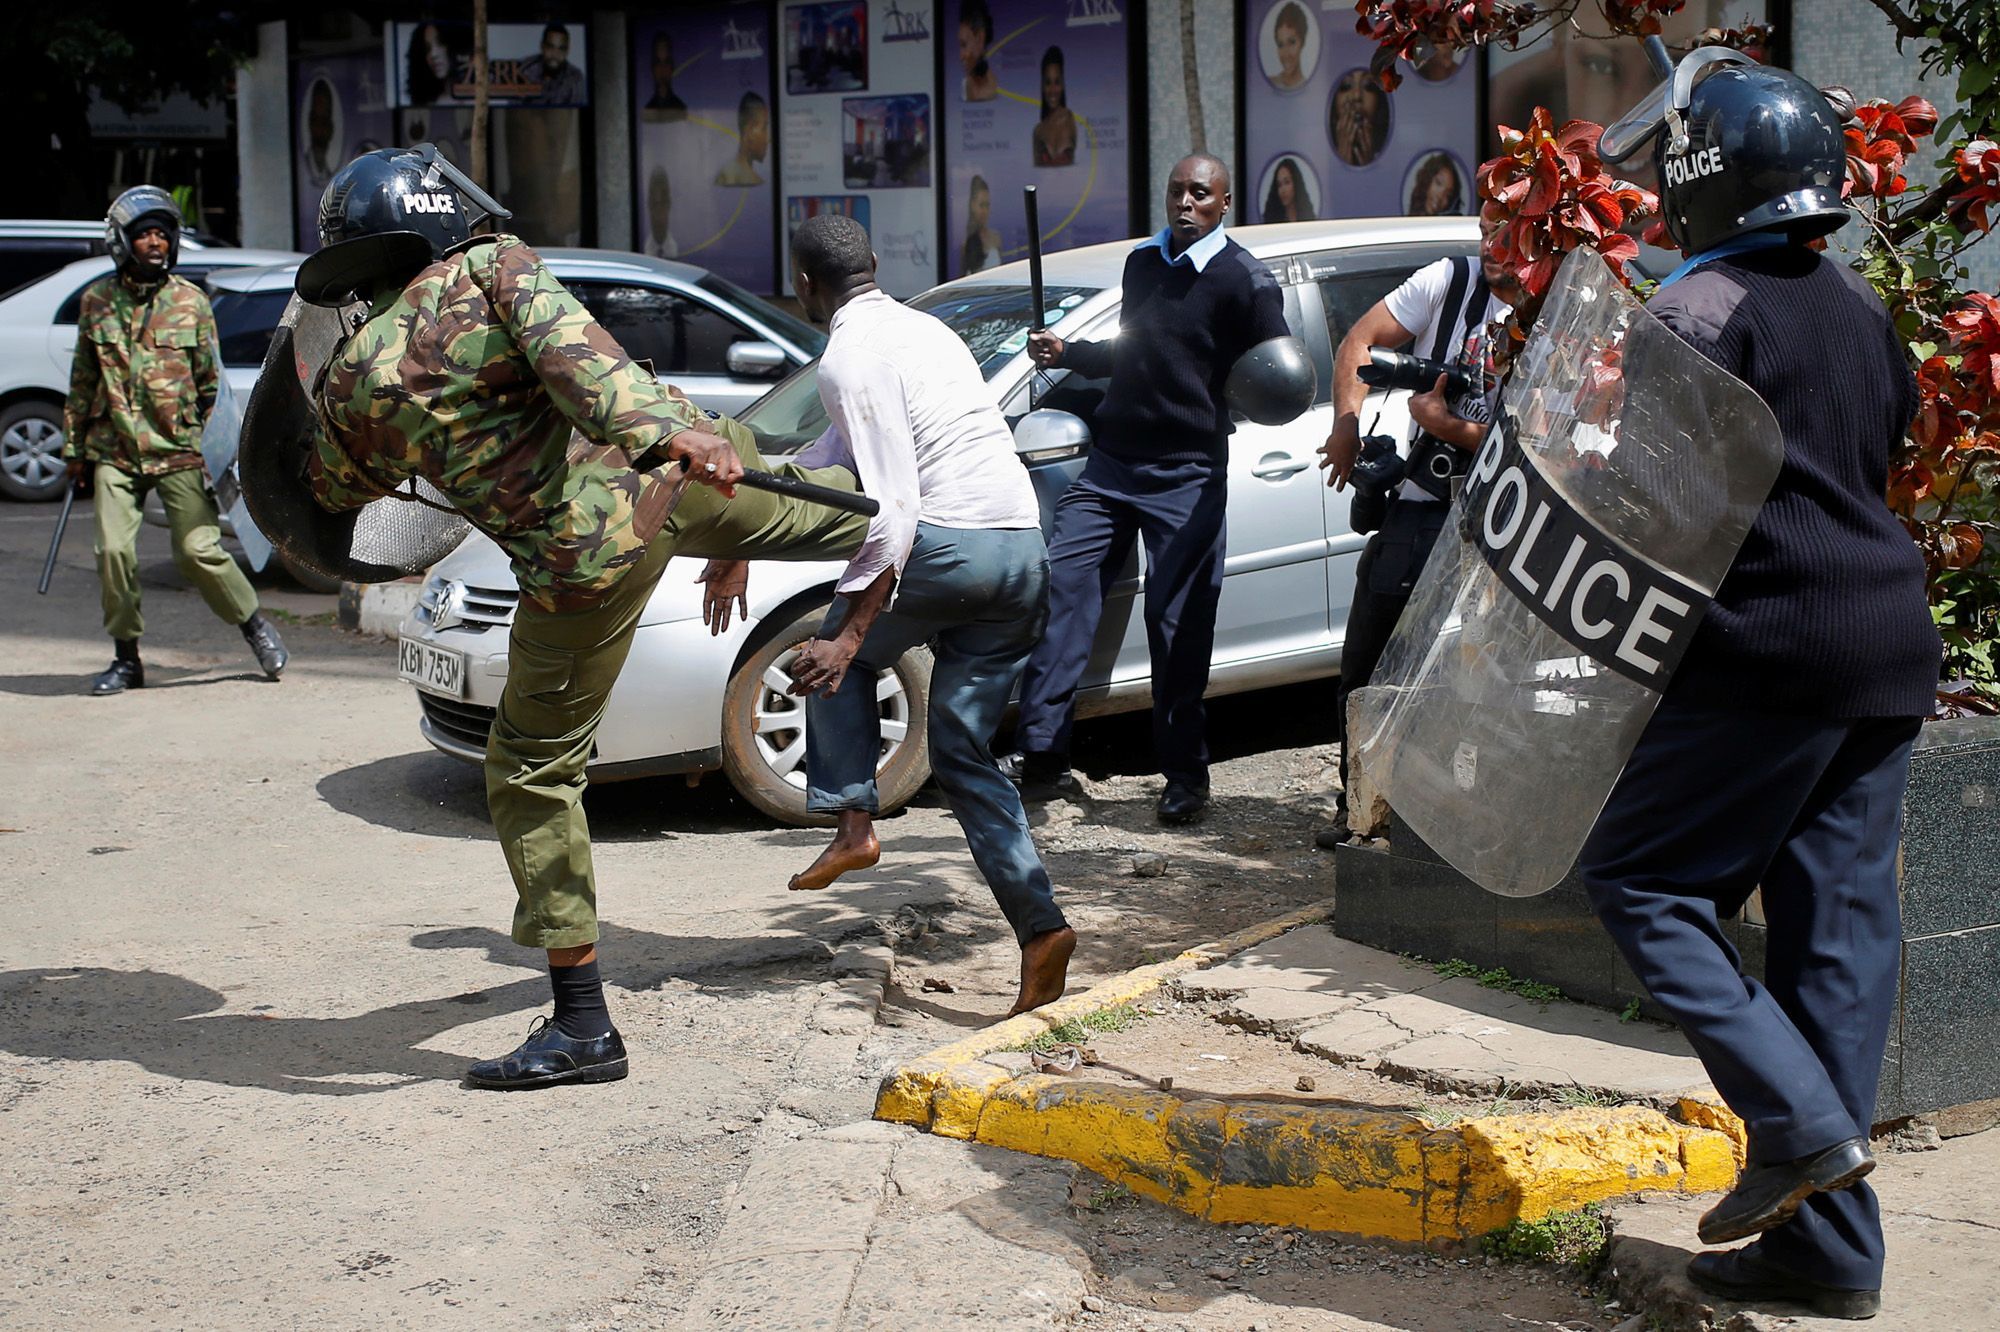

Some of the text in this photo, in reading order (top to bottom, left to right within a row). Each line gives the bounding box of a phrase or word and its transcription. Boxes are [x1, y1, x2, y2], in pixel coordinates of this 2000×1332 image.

[1665, 146, 1724, 188] POLICE
[402, 193, 456, 214] POLICE
[1465, 420, 1691, 675] POLICE
[428, 650, 460, 692] 753M
